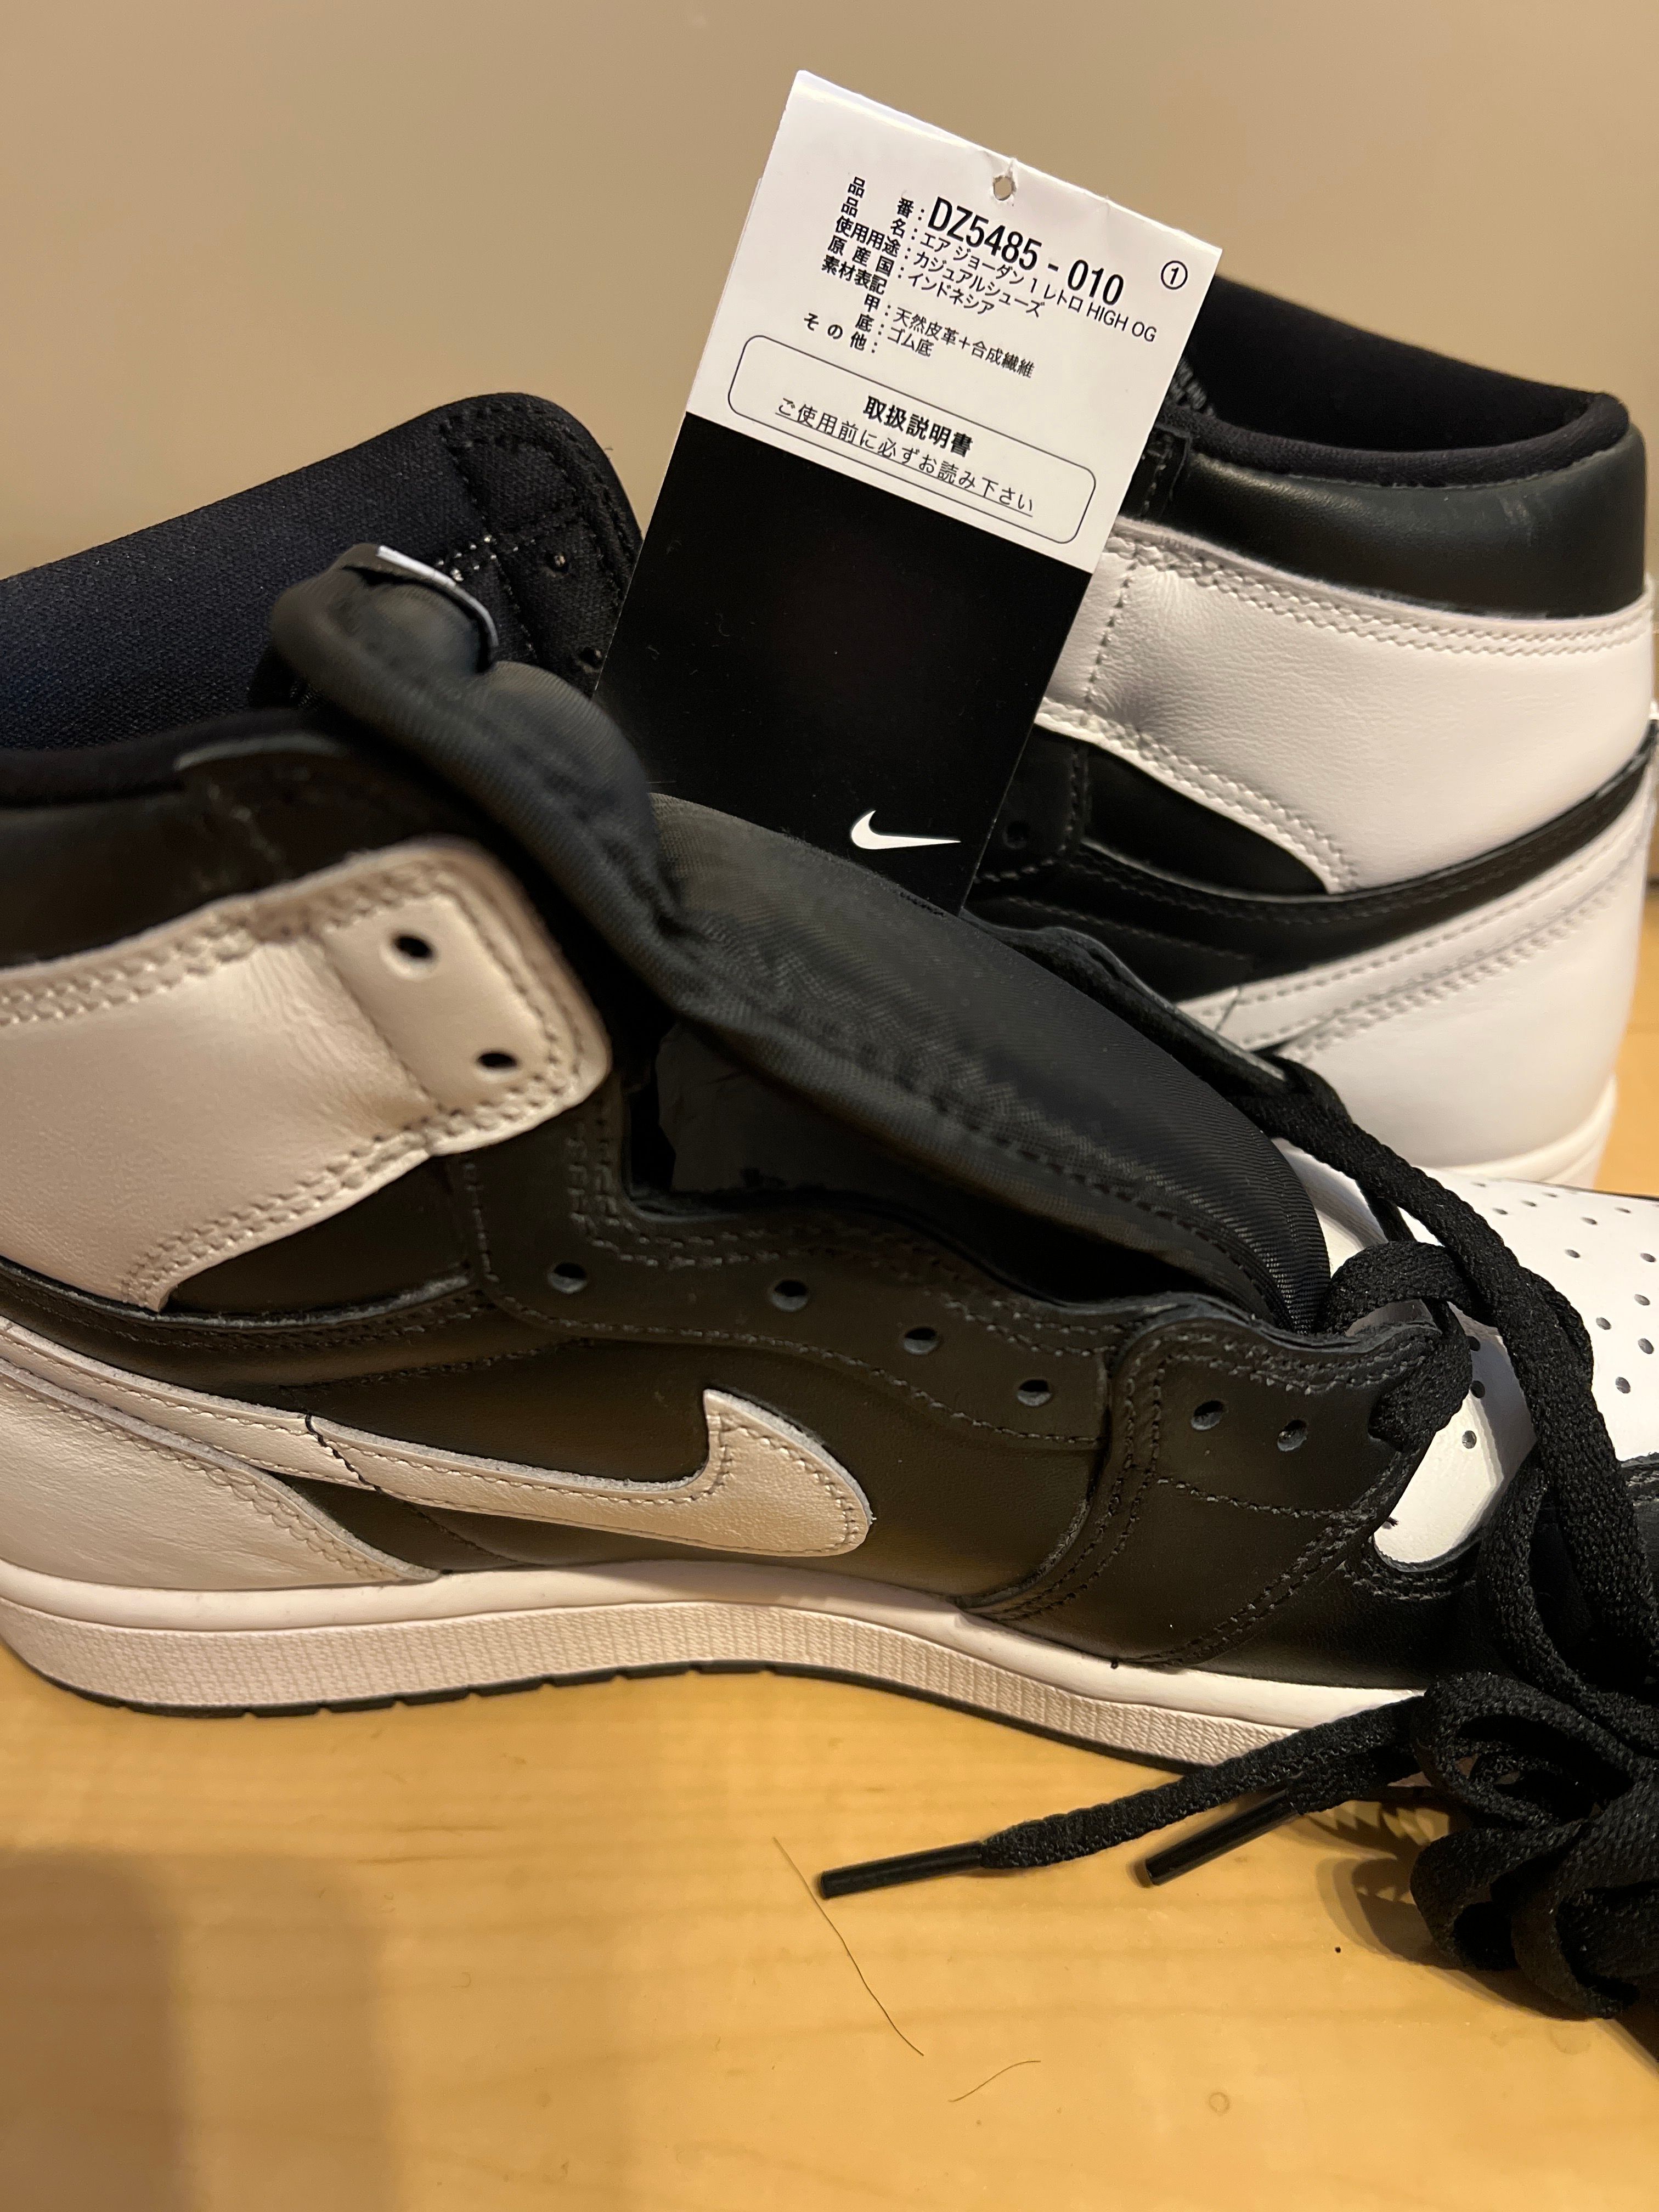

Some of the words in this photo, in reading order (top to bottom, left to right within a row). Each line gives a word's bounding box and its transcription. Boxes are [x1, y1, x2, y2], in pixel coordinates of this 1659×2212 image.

[821, 254, 888, 296] 素材表記
[928, 196, 1042, 270] DZ5485
[1066, 259, 1125, 306] 010
[908, 273, 995, 315] インドネシア
[913, 251, 1045, 318] カジュアルシューズ
[919, 232, 951, 253] エア
[1043, 283, 1084, 313] レトロ
[1086, 302, 1130, 331] HIGH
[1132, 321, 1158, 342] OG
[887, 326, 934, 358] ゴム底
[777, 397, 1034, 512] ご使用前に必ずお読み下さい
[862, 394, 974, 458] 取扱説明書
